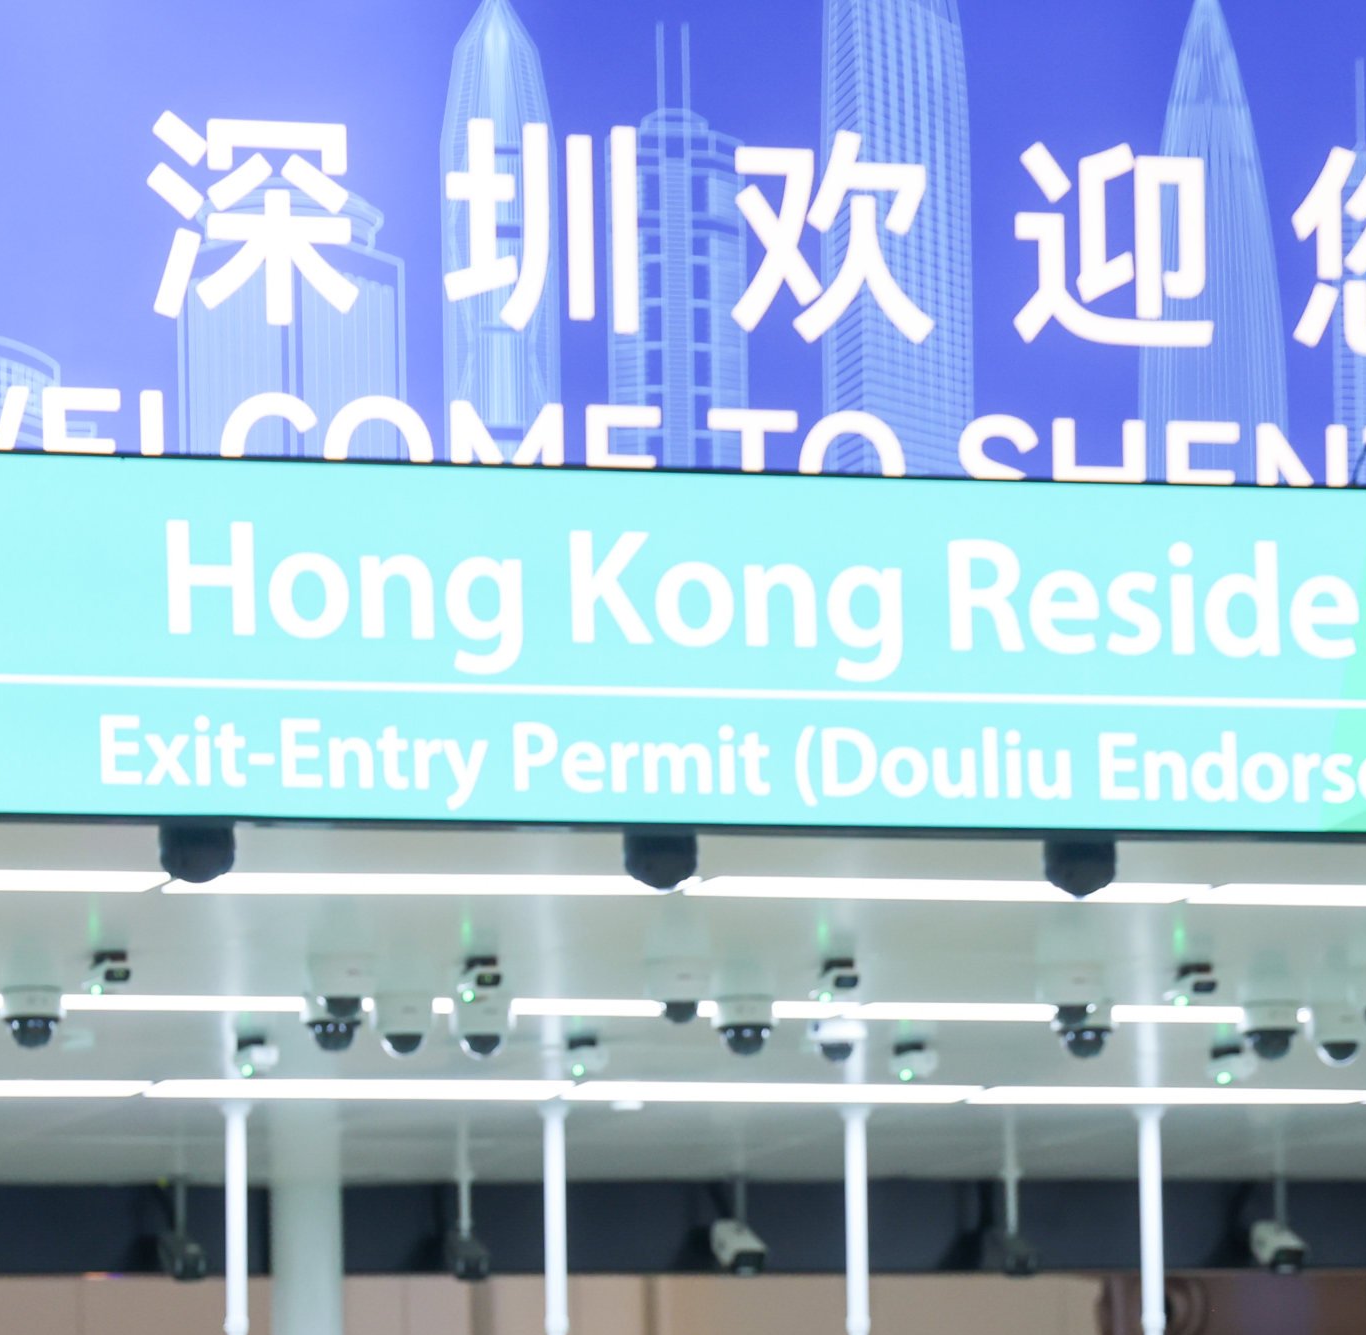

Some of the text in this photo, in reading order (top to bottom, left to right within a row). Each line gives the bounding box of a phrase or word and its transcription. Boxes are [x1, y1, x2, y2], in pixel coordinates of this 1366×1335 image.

[707, 408, 908, 476] TO
[165, 519, 524, 676] Hong
[568, 529, 903, 682] Kong
[99, 714, 488, 812] Exit-Entry
[513, 721, 771, 796] Permit
[795, 725, 1072, 807] (Douliu
